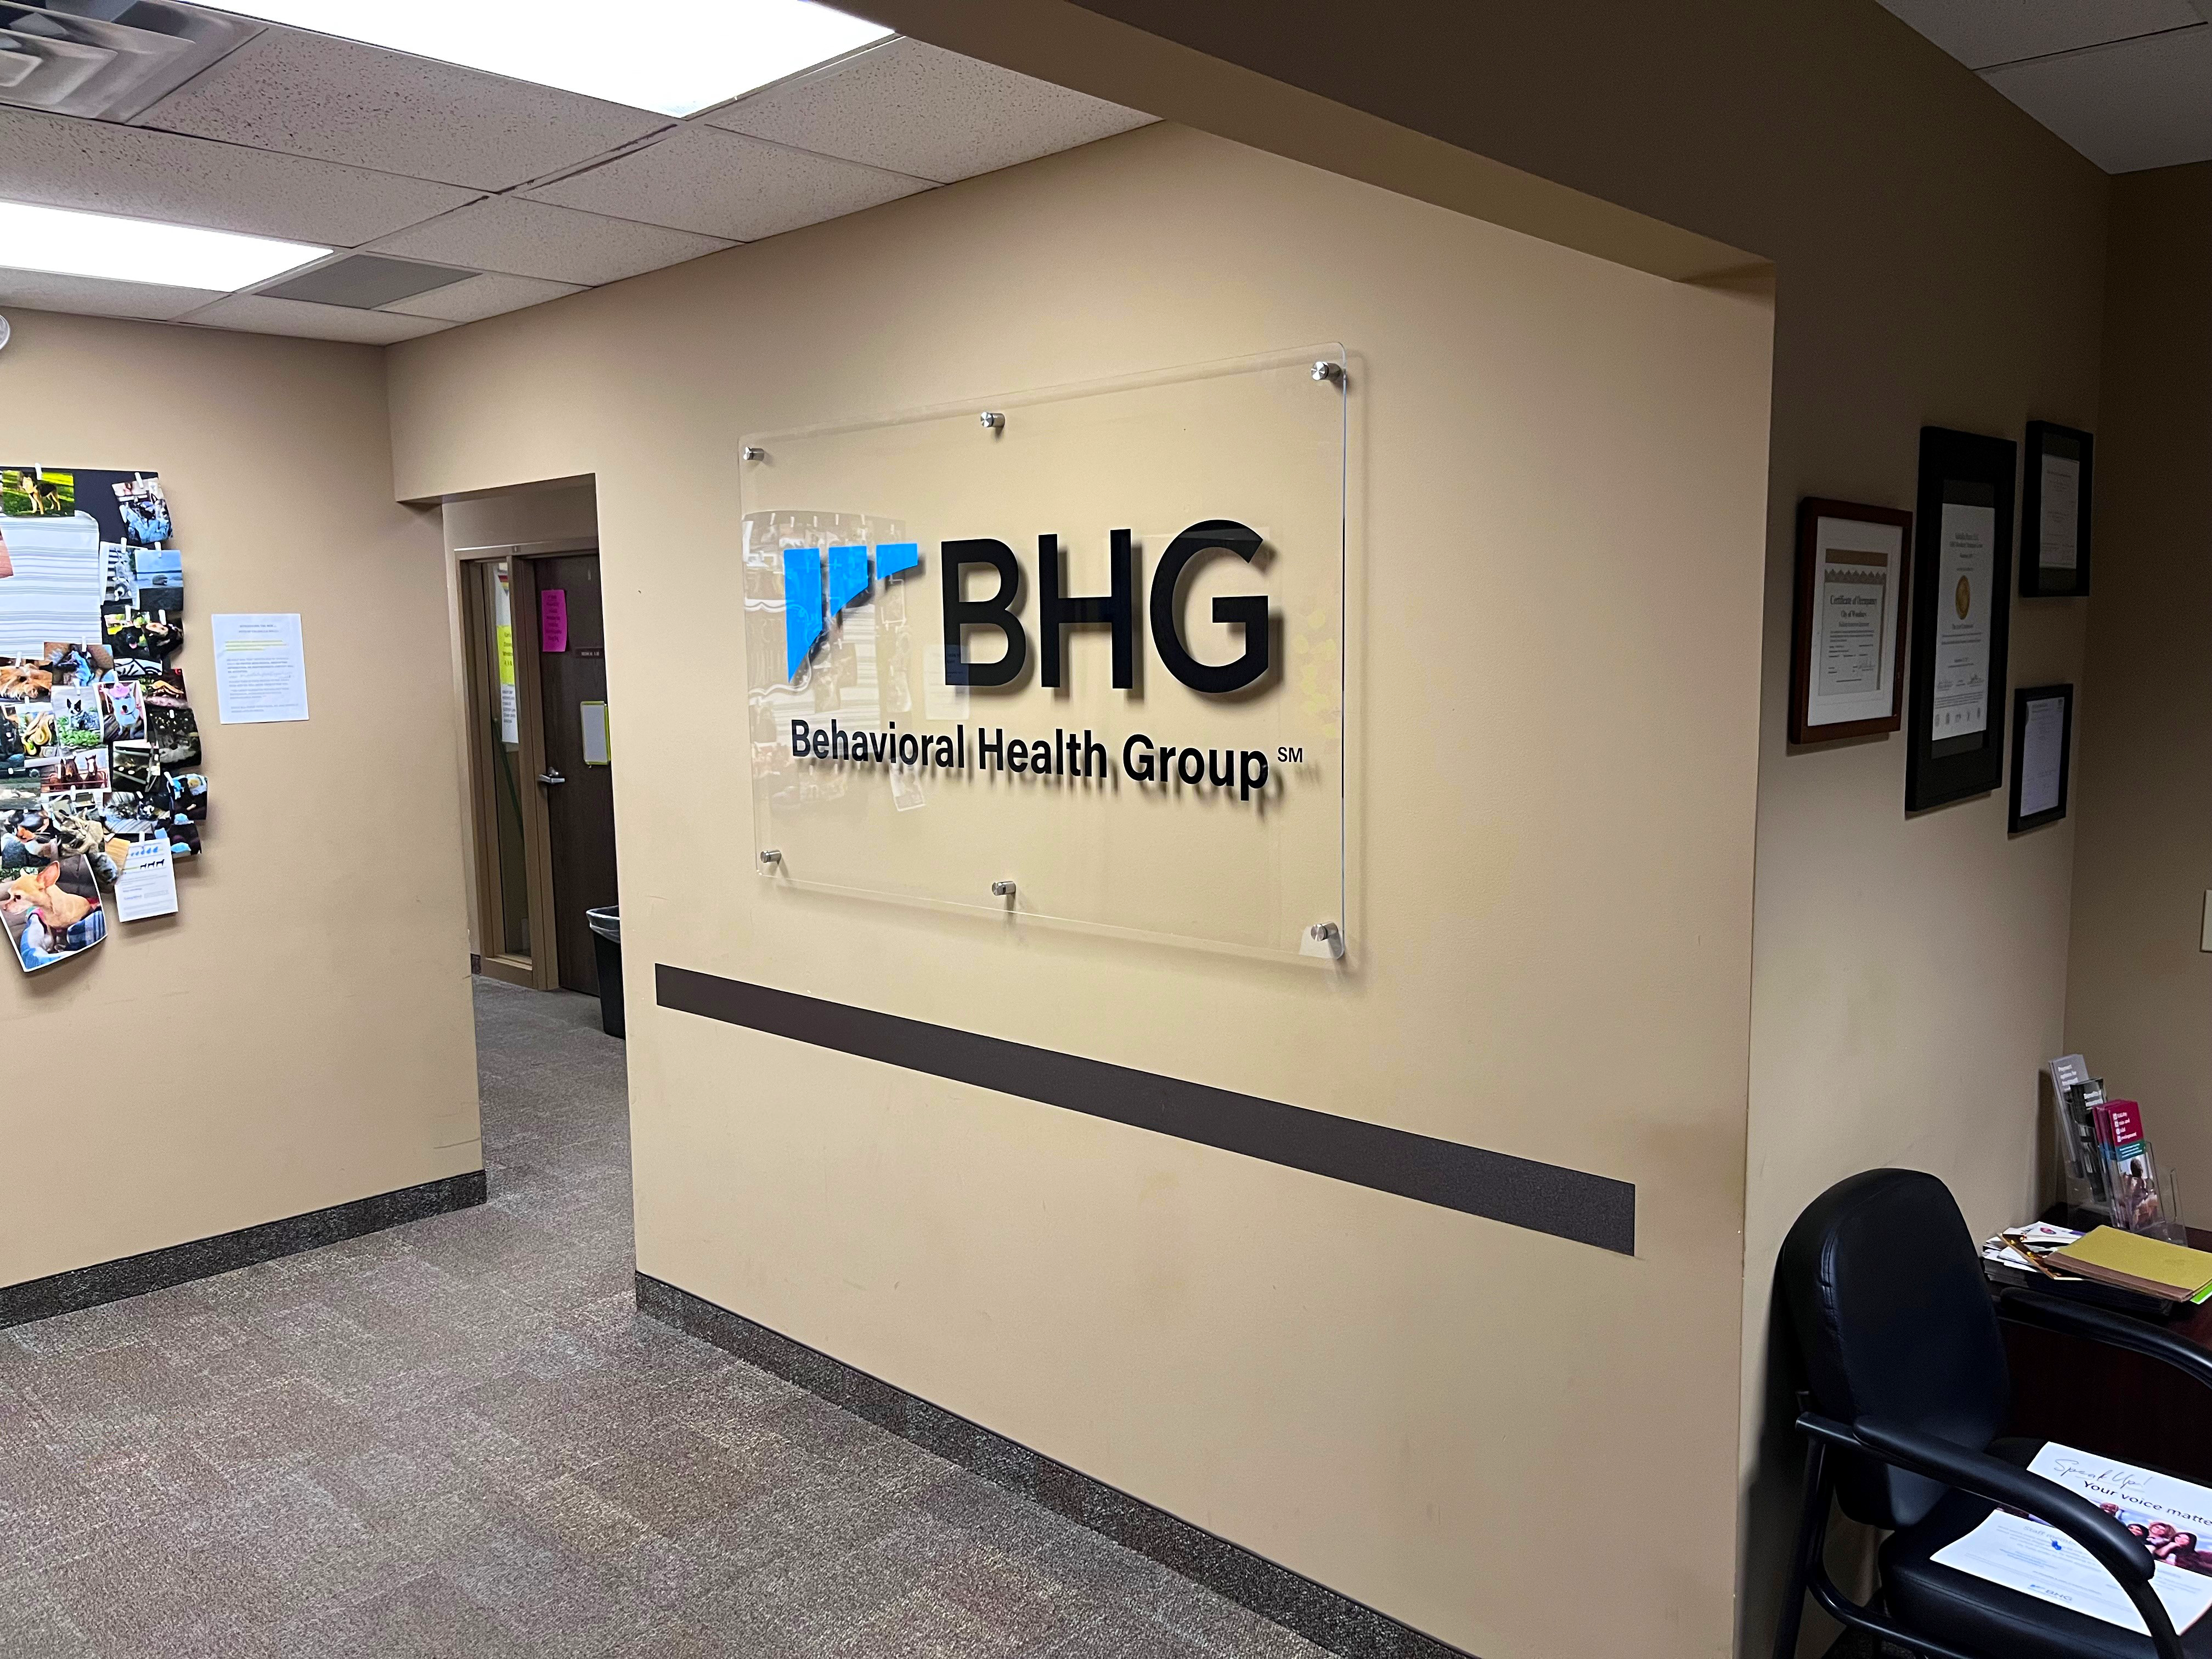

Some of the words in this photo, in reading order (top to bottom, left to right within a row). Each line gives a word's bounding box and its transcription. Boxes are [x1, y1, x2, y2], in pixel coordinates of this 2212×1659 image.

[940, 519, 1269, 694] BHG
[791, 718, 965, 769] Behavioral
[978, 727, 1107, 778] Health
[1122, 733, 1269, 802] Group
[1277, 746, 1303, 763] SM
[2053, 1458, 2113, 1482] Speak
[2084, 1480, 2118, 1496] Your
[2121, 1493, 2163, 1510] voice
[2023, 1526, 2046, 1536] Staff
[2045, 1589, 2073, 1602] BHG
